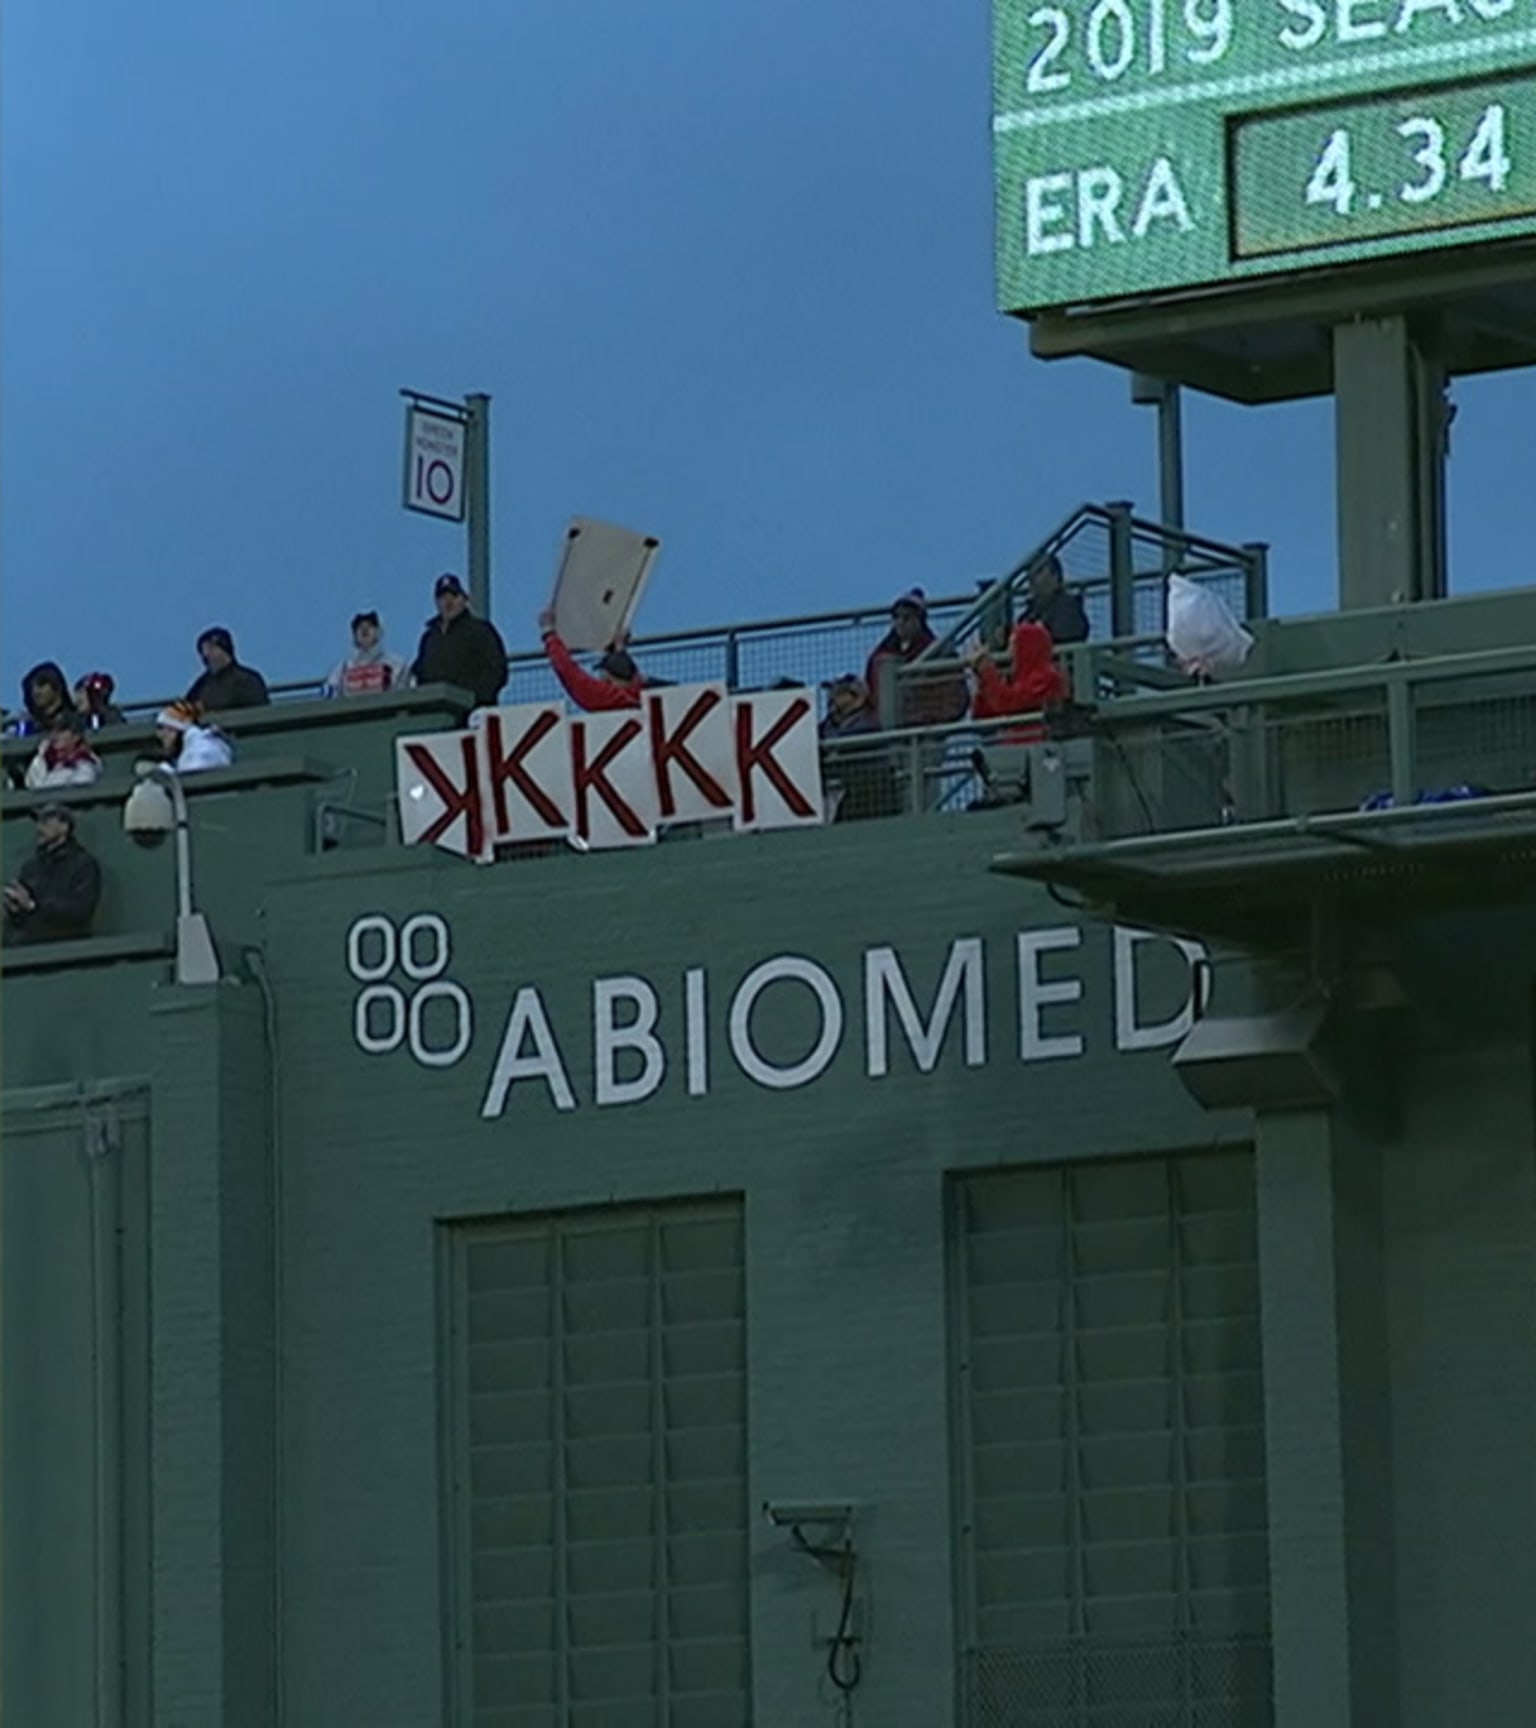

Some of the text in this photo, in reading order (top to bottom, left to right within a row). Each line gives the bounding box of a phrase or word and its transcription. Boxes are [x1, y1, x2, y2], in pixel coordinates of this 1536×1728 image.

[1026, 0, 1514, 92] 2019 SE
[1025, 104, 1511, 256] ERA 4.34
[417, 456, 454, 504] 10
[481, 924, 1211, 1117] ABIOMED
